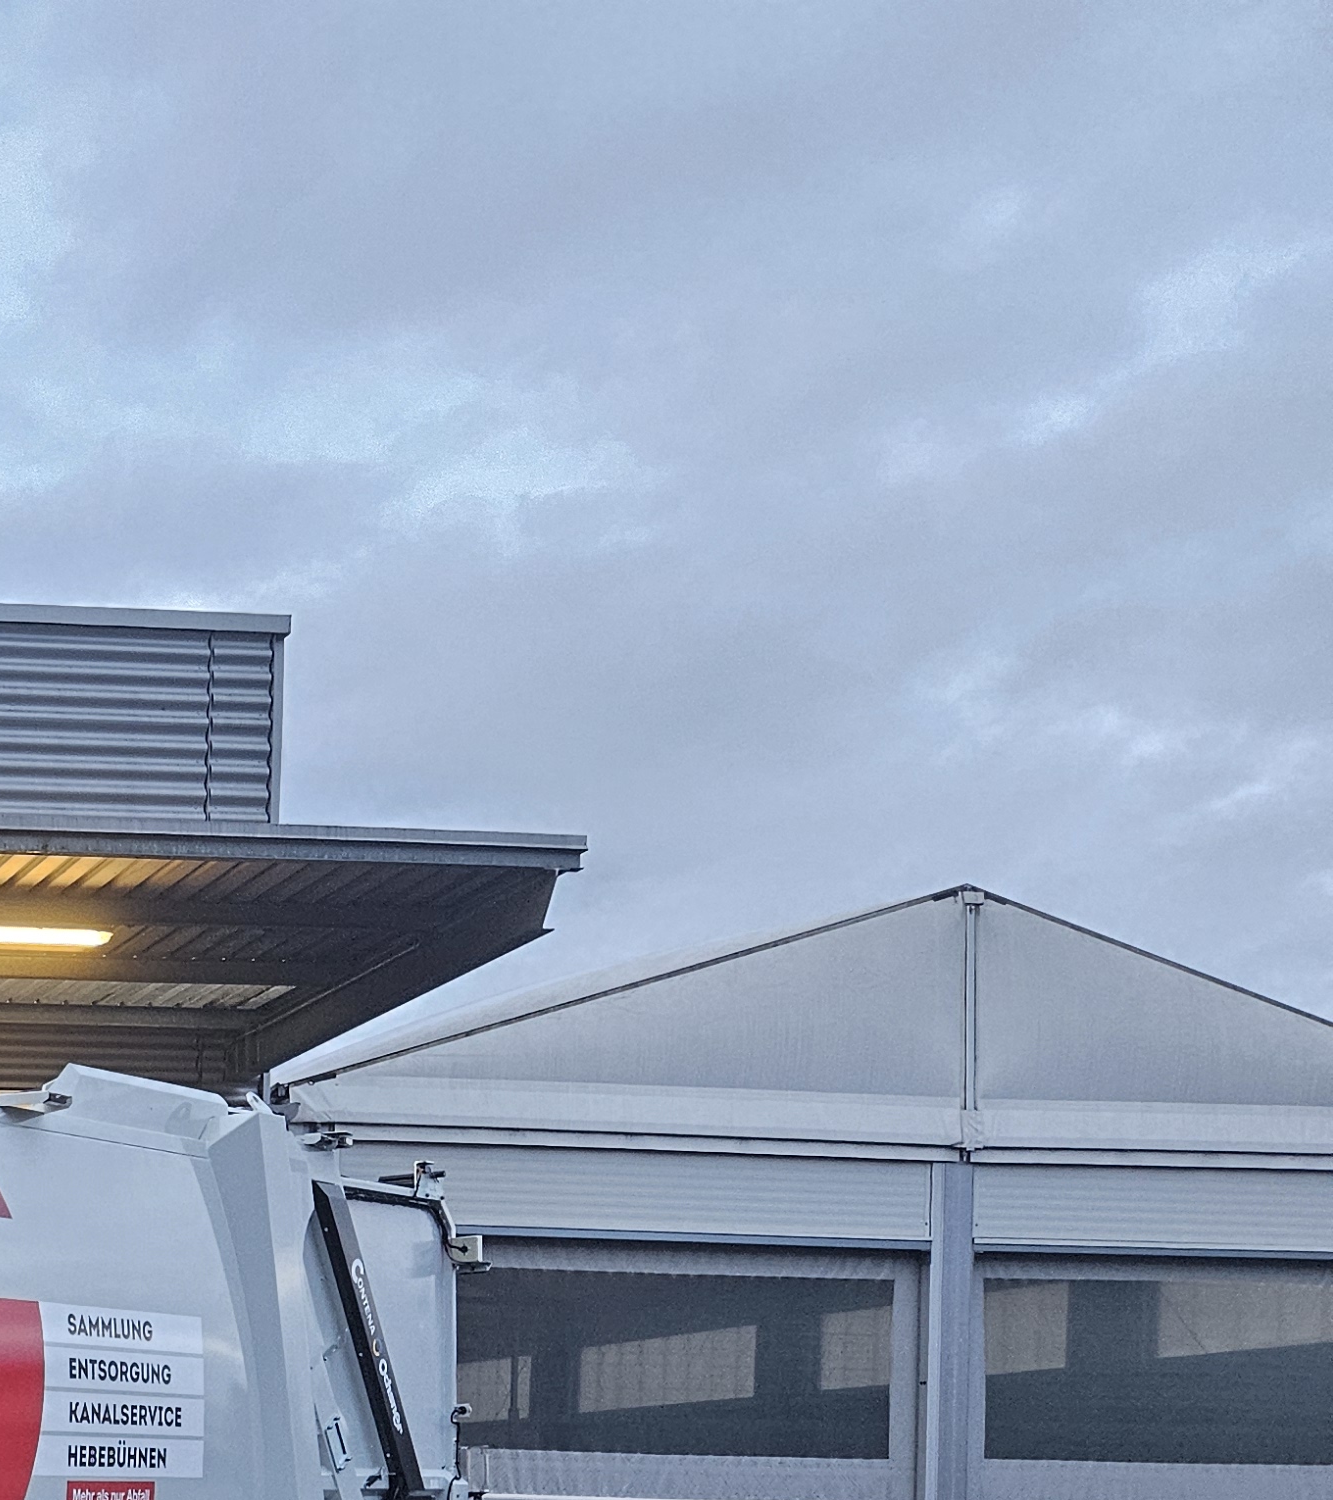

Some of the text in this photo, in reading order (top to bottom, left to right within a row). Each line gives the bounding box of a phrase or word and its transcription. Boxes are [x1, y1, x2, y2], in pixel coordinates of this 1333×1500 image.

[351, 1258, 376, 1336] CONTENA
[67, 1313, 153, 1342] SAMMLUNG
[69, 1357, 172, 1385] ENTSORGUNG
[69, 1401, 182, 1427] KANALSERVICE
[67, 1440, 167, 1468] HEBEBÜHNEN
